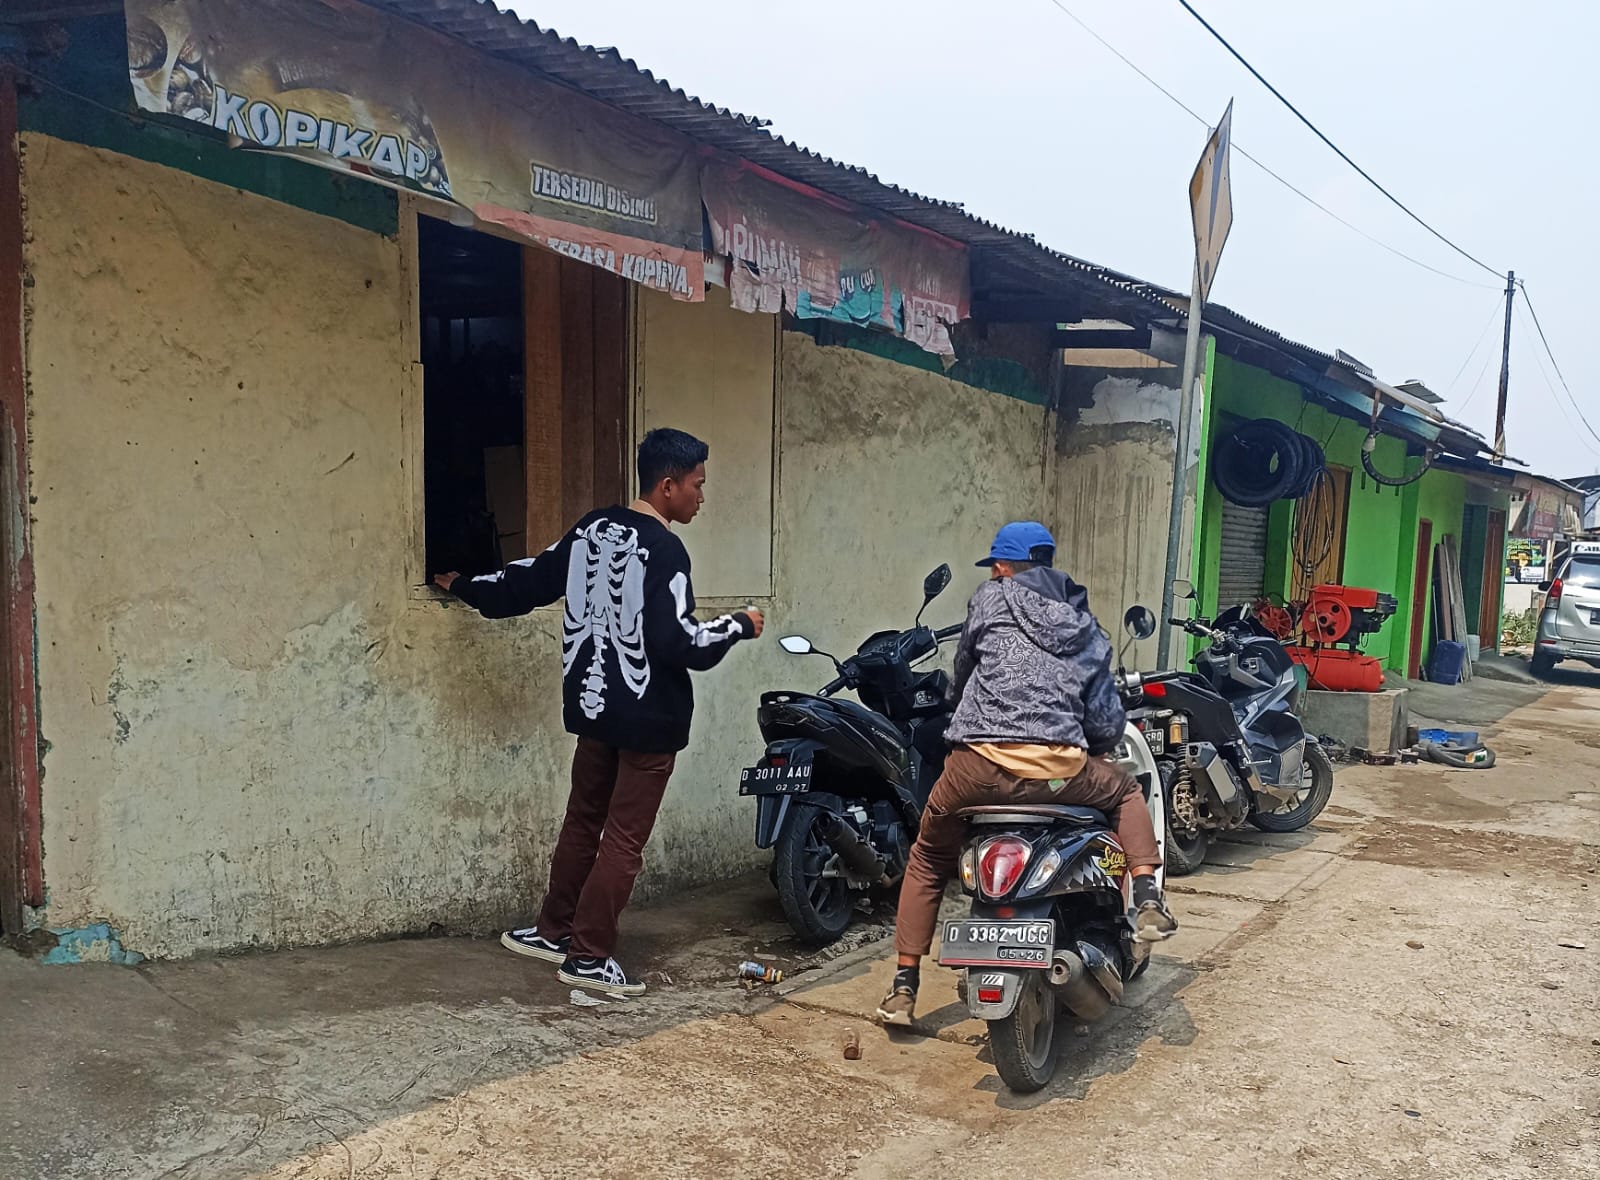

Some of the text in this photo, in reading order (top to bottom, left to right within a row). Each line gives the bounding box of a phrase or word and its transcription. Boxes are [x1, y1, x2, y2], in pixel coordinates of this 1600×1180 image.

[213, 84, 430, 178] KOPIKAP
[532, 165, 604, 210] TERSEDIA
[741, 765, 811, 781] D 3011 AAU
[949, 926, 959, 942] D
[968, 926, 1009, 942] 3382
